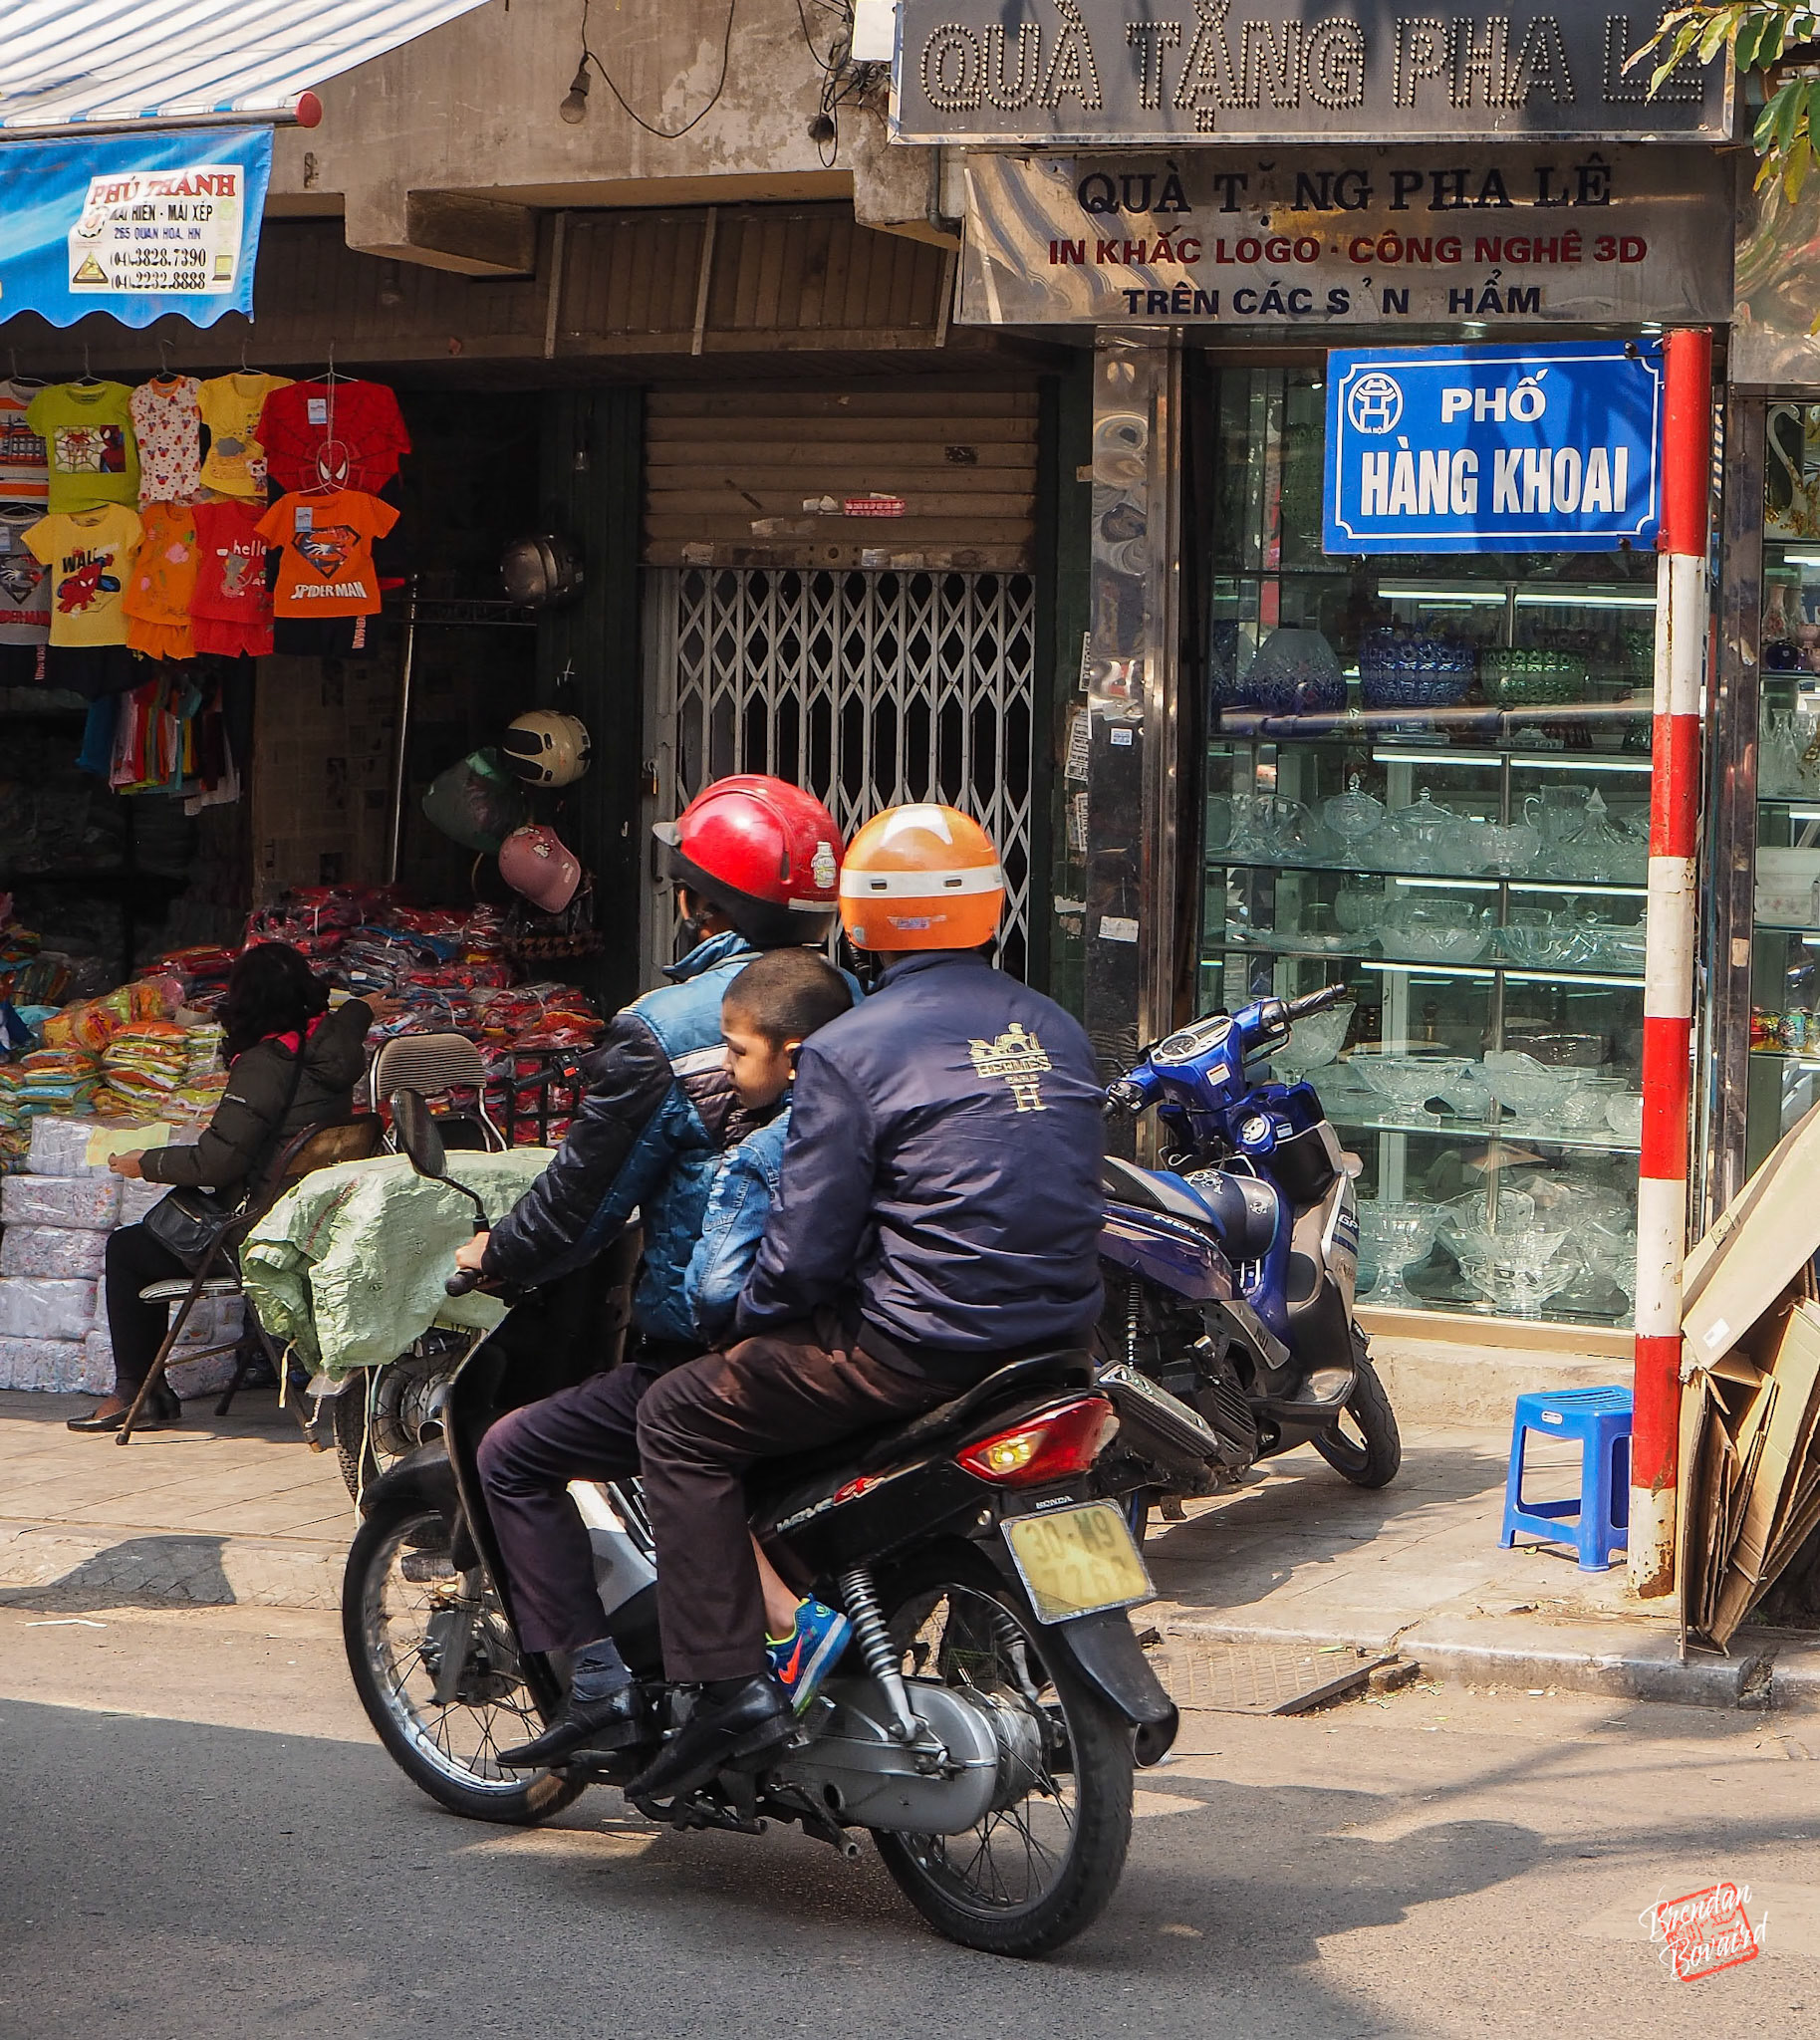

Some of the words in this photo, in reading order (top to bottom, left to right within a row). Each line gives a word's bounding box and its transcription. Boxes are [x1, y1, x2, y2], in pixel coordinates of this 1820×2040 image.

[920, 0, 1102, 109] QUÀ
[1393, 15, 1576, 106] PHA
[91, 176, 141, 205] PHÚ
[1078, 160, 1192, 214] QUÀ
[1390, 167, 1514, 212] PHA
[1534, 151, 1612, 207] LÊ
[1049, 239, 1086, 265] IN
[1096, 225, 1201, 265] KHẮC
[1215, 236, 1321, 264] LOGO
[1348, 228, 1462, 264] CÔNG
[1594, 235, 1649, 264] 3D
[1122, 281, 1220, 315] TRÊN
[1232, 280, 1313, 315] CÁC
[1440, 368, 1548, 423] PHỐ
[1360, 435, 1479, 517] HÀNG
[1492, 446, 1629, 514] KHOAI
